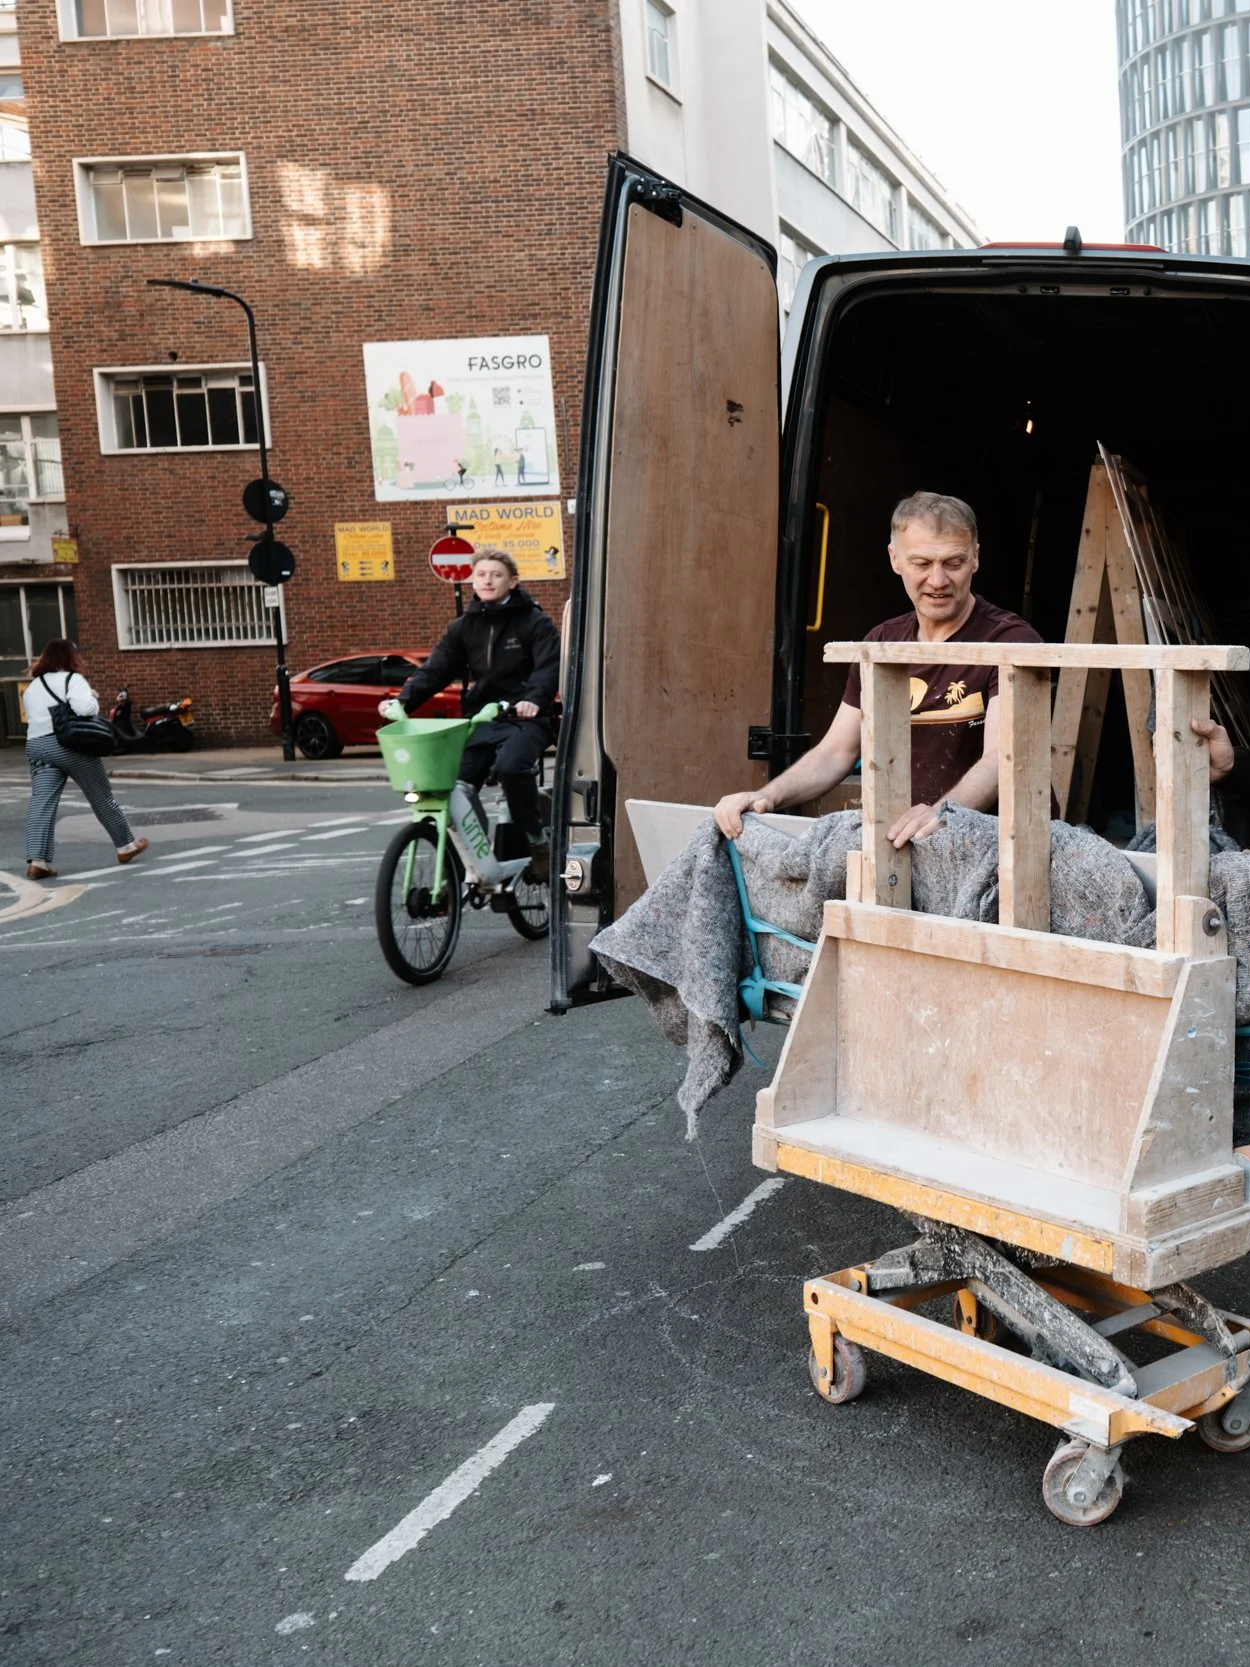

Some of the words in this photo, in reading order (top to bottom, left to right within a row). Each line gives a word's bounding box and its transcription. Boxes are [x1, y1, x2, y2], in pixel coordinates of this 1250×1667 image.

[467, 354, 542, 371] FASGRO
[455, 508, 490, 520] MAD
[496, 506, 554, 519] WORLD
[462, 807, 489, 859] Lime
